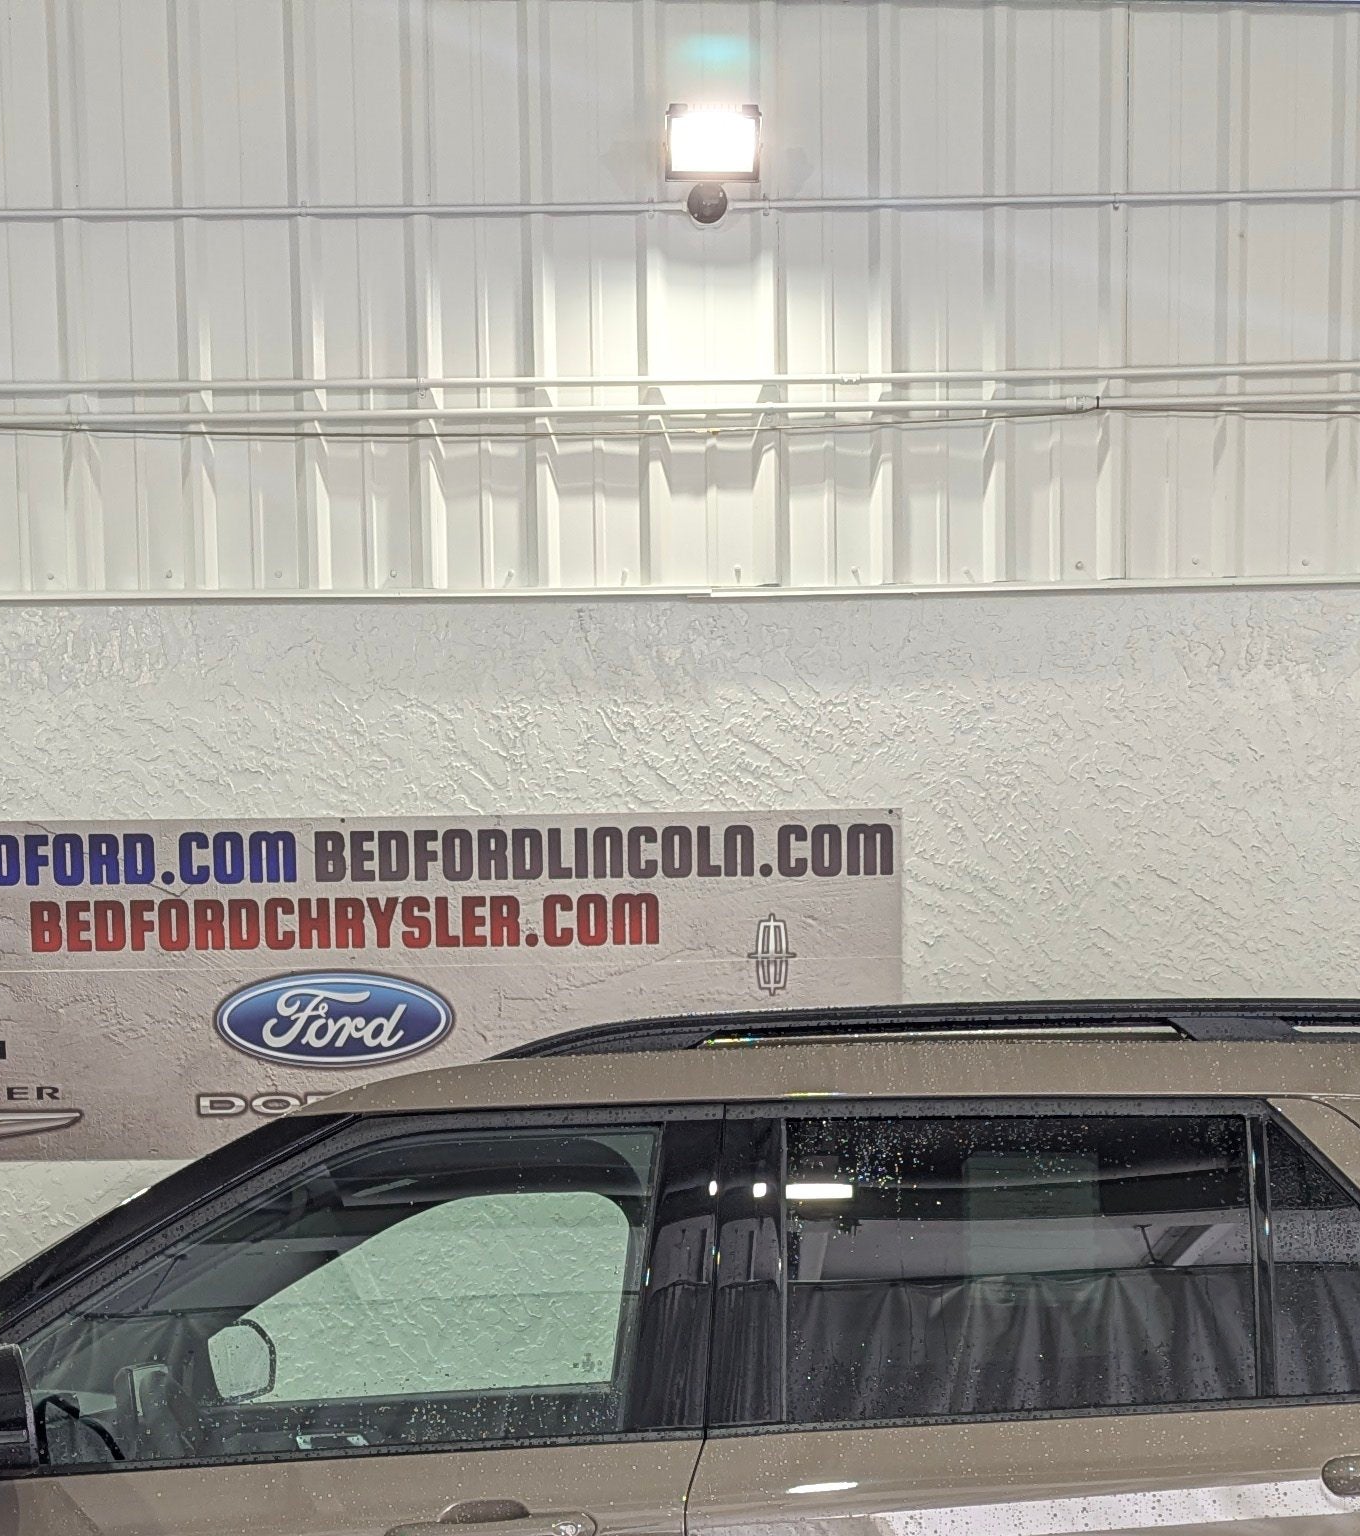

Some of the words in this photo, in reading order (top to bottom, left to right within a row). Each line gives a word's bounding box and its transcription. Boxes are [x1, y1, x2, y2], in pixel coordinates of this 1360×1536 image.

[314, 824, 894, 882] BEDFORDLINCOLN.COM
[30, 893, 660, 952] BEDFORDCHRYSLER.COM
[262, 988, 408, 1048] Ford
